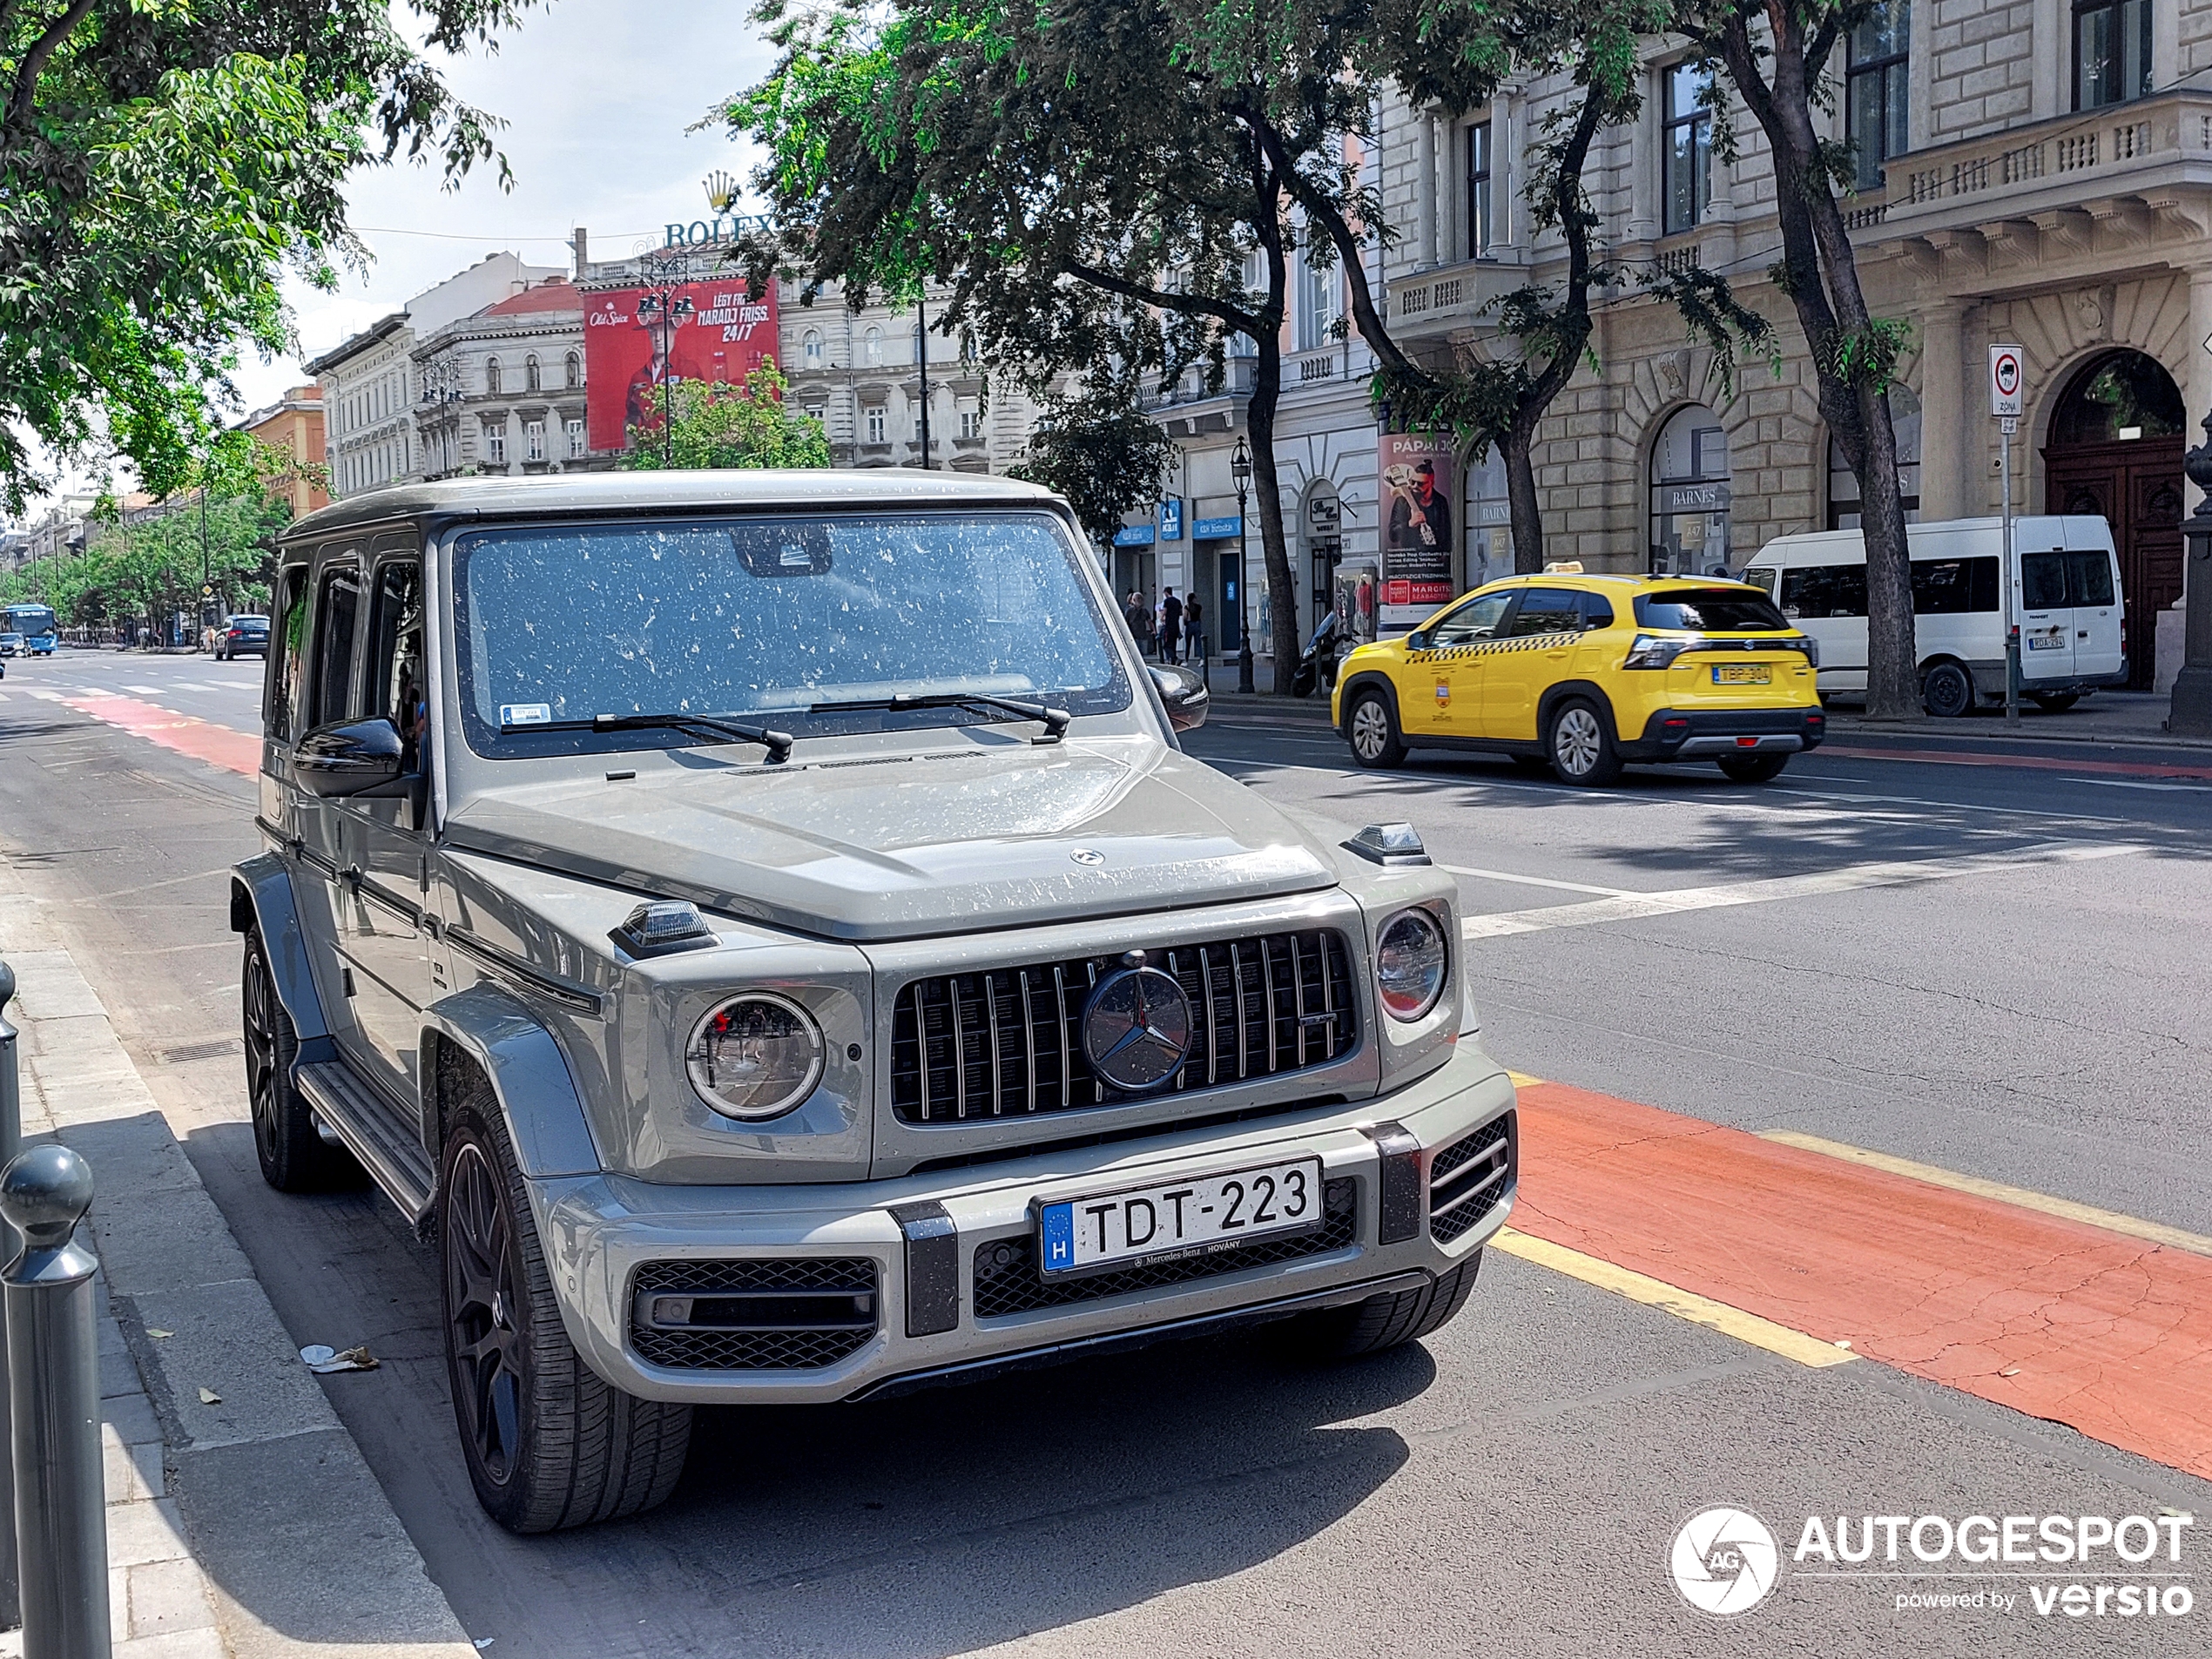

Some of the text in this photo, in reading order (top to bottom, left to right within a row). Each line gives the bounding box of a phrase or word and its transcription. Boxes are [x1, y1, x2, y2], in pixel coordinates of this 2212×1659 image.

[664, 213, 778, 248] ROLEX
[590, 311, 629, 327] Old Spice
[698, 306, 770, 326] MARADJ FRISS.
[2000, 401, 2016, 412] ZÓNA
[1673, 489, 1716, 505] BARNES
[1052, 1170, 1306, 1260] H TDT-223
[1145, 1240, 1241, 1264] Mercedes-Benz HOVÁNY
